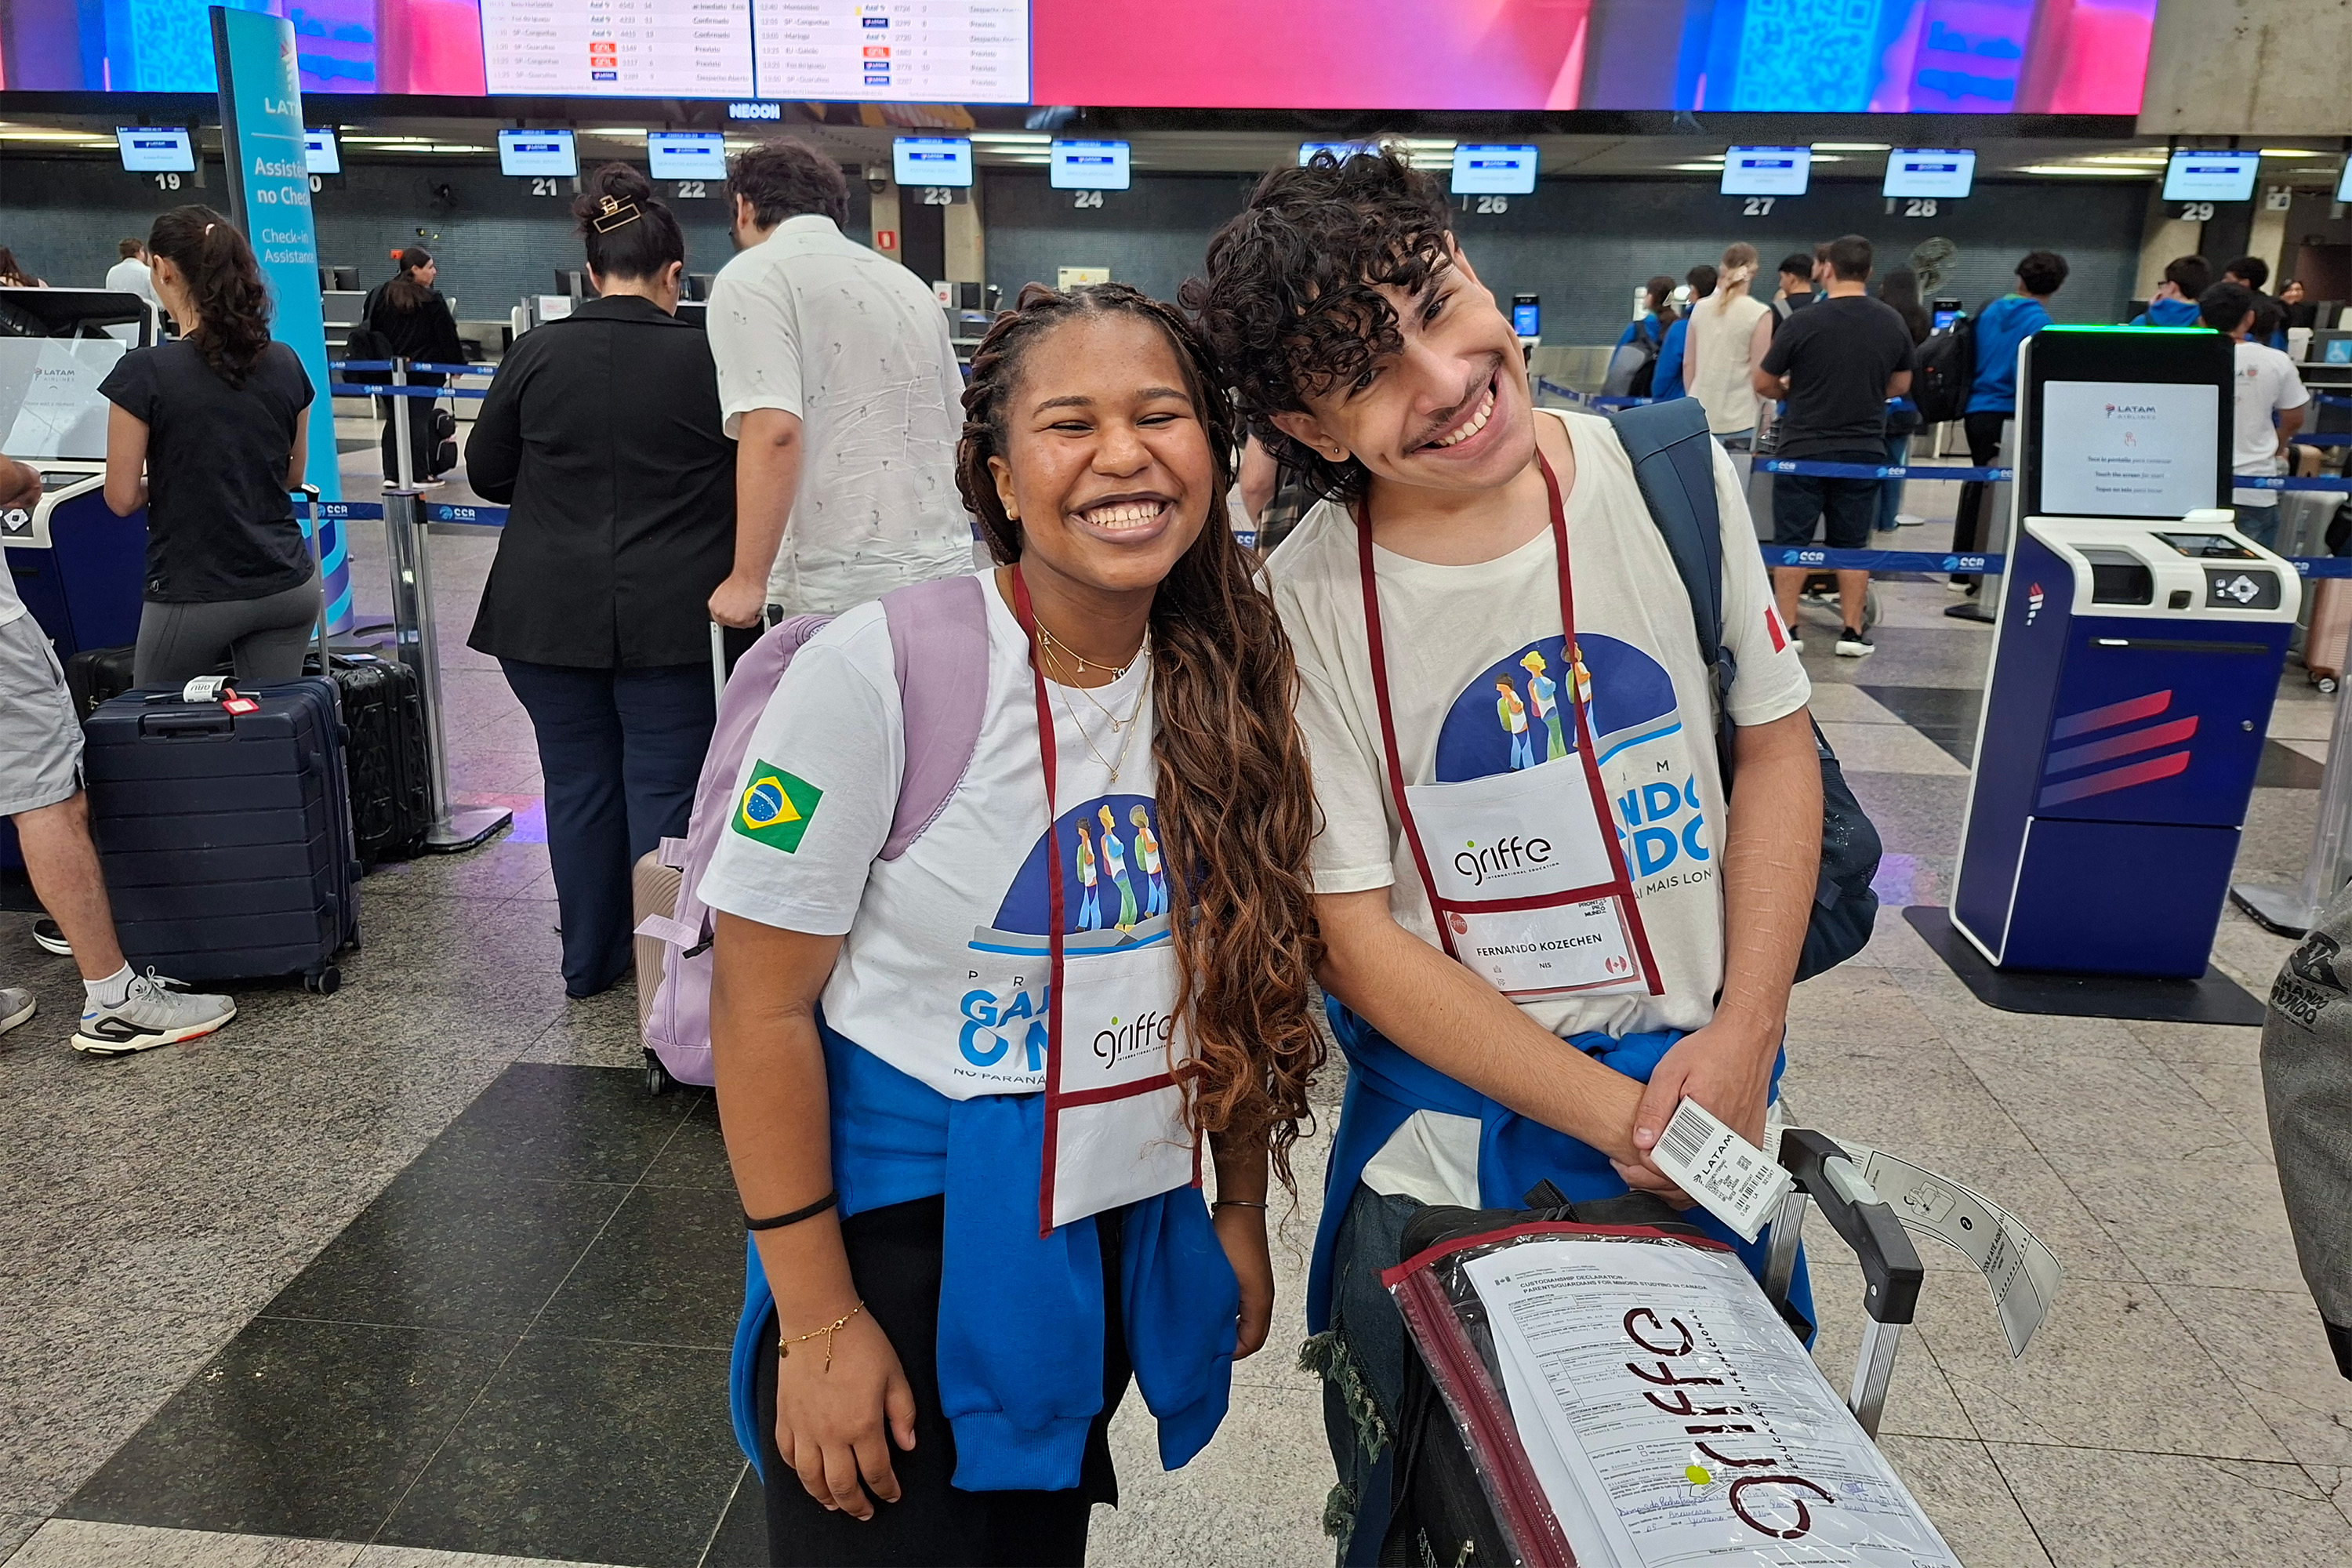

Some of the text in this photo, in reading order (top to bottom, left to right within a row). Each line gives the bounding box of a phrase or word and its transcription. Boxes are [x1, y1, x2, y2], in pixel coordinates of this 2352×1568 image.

[729, 103, 781, 120] NEOOH
[155, 172, 181, 191] 19
[308, 174, 322, 193] 0
[531, 178, 558, 197] 21
[677, 180, 706, 199] 22
[257, 188, 278, 204] no
[923, 187, 953, 205] 23
[1073, 191, 1105, 209] 24
[1476, 195, 1508, 215] 26
[1742, 197, 1777, 216] 27
[1904, 198, 1939, 218] 28
[2180, 201, 2216, 222] 29
[262, 228, 309, 245] Check-in
[326, 505, 348, 514] CCR
[454, 508, 476, 518] CCR
[1799, 551, 1825, 562] CCR
[1959, 557, 1985, 568] CCR
[1454, 835, 1552, 887] griffe
[1485, 862, 1560, 880] INTERNATIONAL EDUCATION
[1646, 876, 1679, 896] MAIS
[1476, 933, 1602, 957] FERNANDO KOZECHEN
[1701, 1134, 1734, 1175] LATAM
[1762, 1170, 1775, 1186] 321047
[1984, 1257, 1993, 1272] COLE
[1520, 1276, 1575, 1288] CUSTODIANSHIP
[1523, 1280, 1597, 1294] PARENTS/GUARDIANS
[1688, 1308, 1751, 1397] INTERNACIONAL
[1624, 1307, 1835, 1540] griffe
